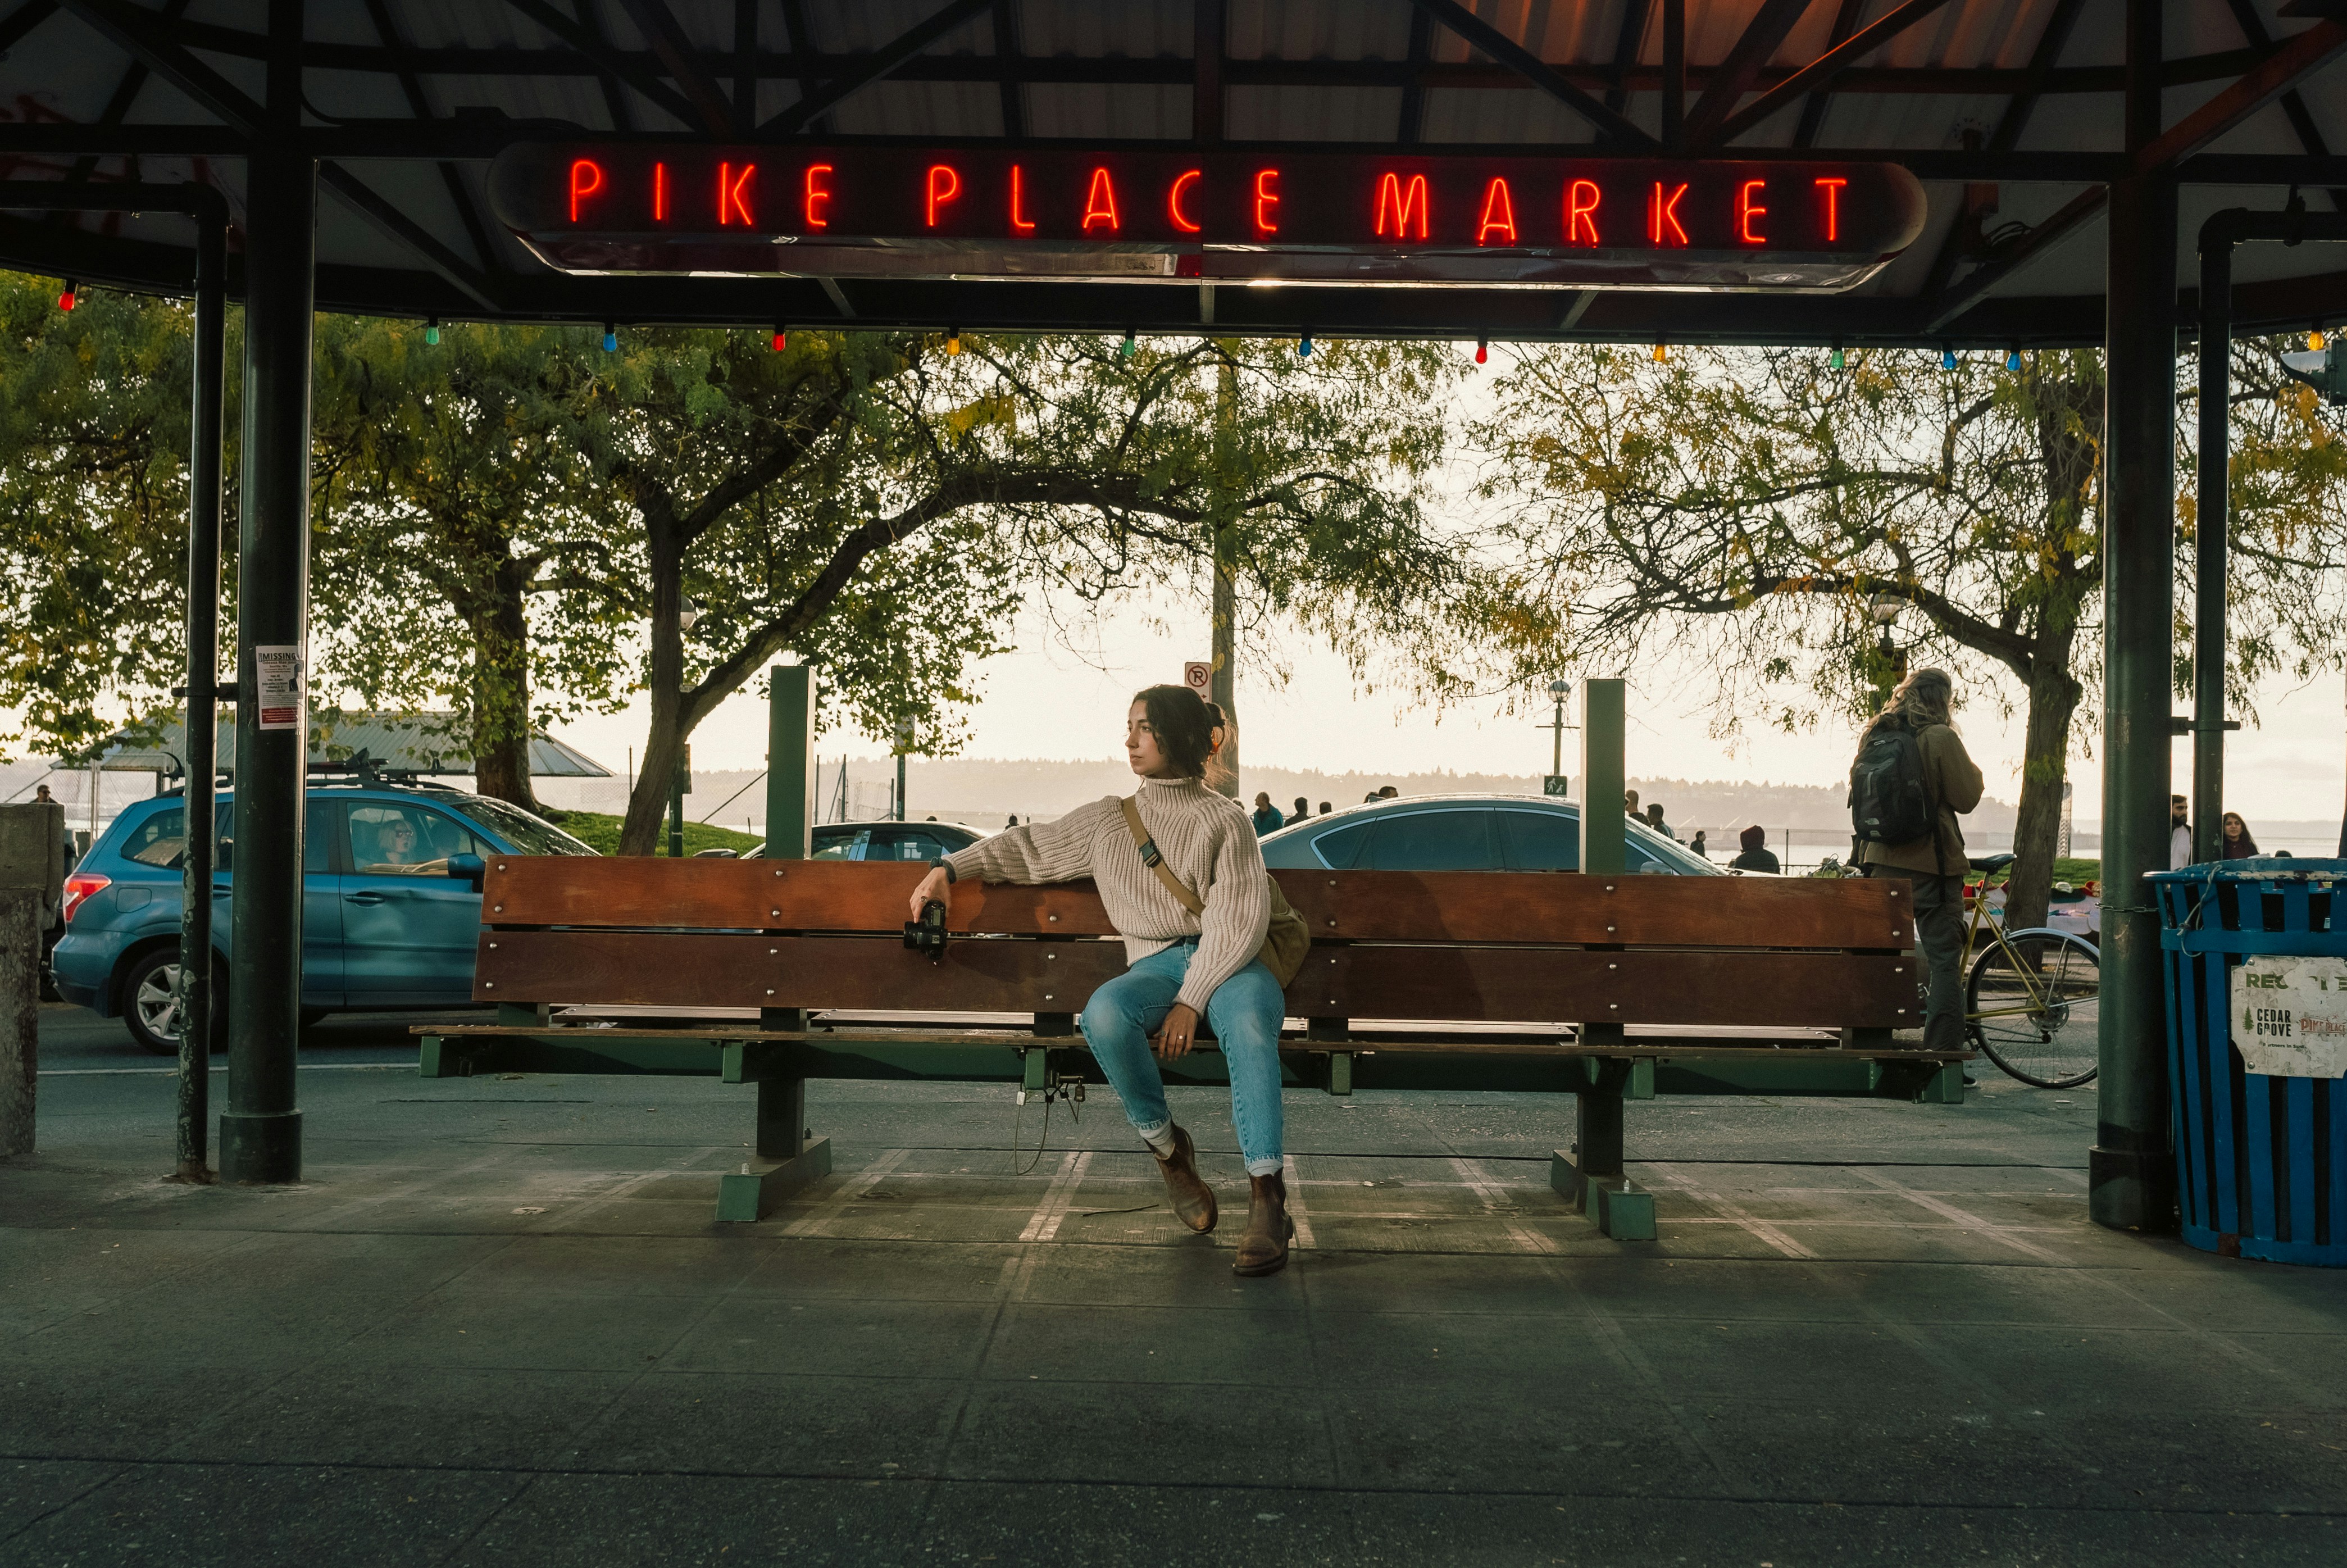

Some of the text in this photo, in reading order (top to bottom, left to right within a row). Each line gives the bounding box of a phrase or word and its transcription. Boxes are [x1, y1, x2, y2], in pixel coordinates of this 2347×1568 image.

[570, 158, 1848, 247] PIKE PLACE MARKET
[2257, 1008, 2291, 1023] CEDAR
